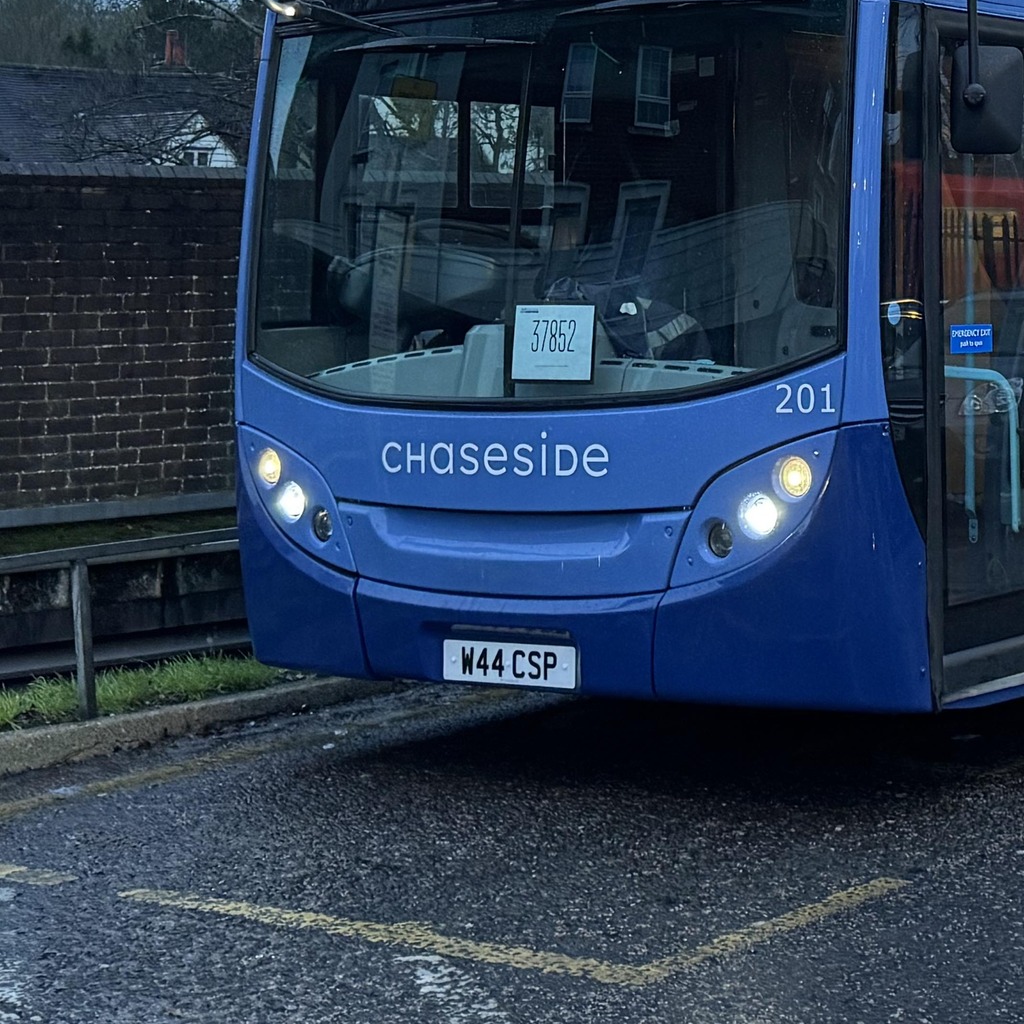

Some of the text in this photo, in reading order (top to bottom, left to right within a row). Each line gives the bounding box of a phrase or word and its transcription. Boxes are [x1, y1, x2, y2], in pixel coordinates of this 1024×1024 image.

[531, 319, 577, 352] 37852
[775, 383, 837, 414] 201
[461, 646, 558, 681] W44 CSP
